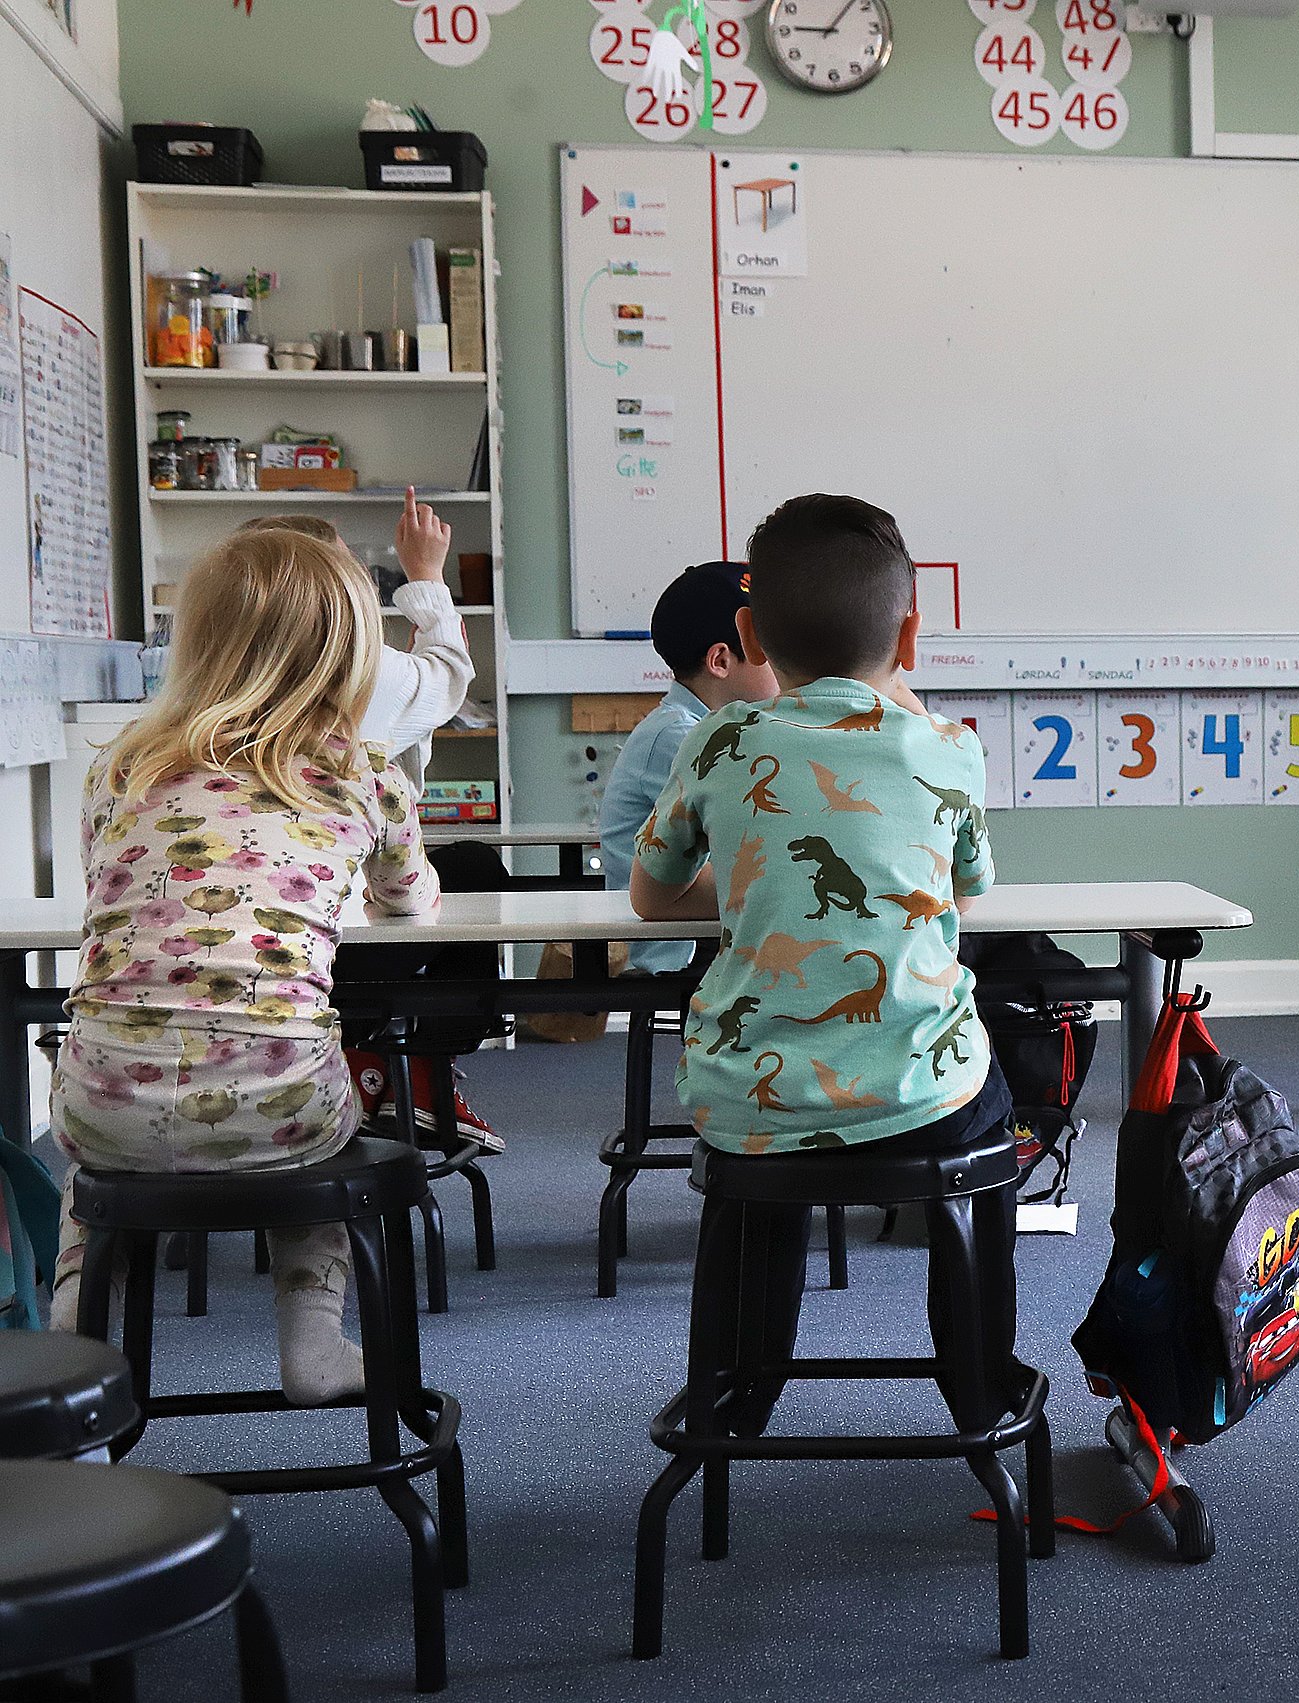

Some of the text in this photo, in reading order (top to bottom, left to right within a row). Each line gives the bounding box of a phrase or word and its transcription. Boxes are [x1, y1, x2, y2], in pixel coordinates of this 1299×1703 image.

[422, 4, 479, 44] 10
[868, 21, 880, 35] 3
[1063, 0, 1117, 34] 48
[601, 26, 651, 66] 25
[982, 35, 1036, 74] 44
[806, 63, 816, 76] 7
[636, 86, 690, 126] 26
[711, 80, 758, 118] 27
[998, 91, 1050, 129] 45
[1065, 92, 1117, 130] 46
[736, 253, 779, 267] Orhan
[731, 282, 766, 297] Iman
[731, 301, 755, 315] Elis
[931, 654, 976, 665] FREDAG
[1015, 669, 1060, 680] LØRDAG
[1087, 669, 1133, 680] SØNDAG
[1032, 713, 1077, 780] 2
[1119, 713, 1157, 779] 3
[1202, 714, 1244, 778] 4
